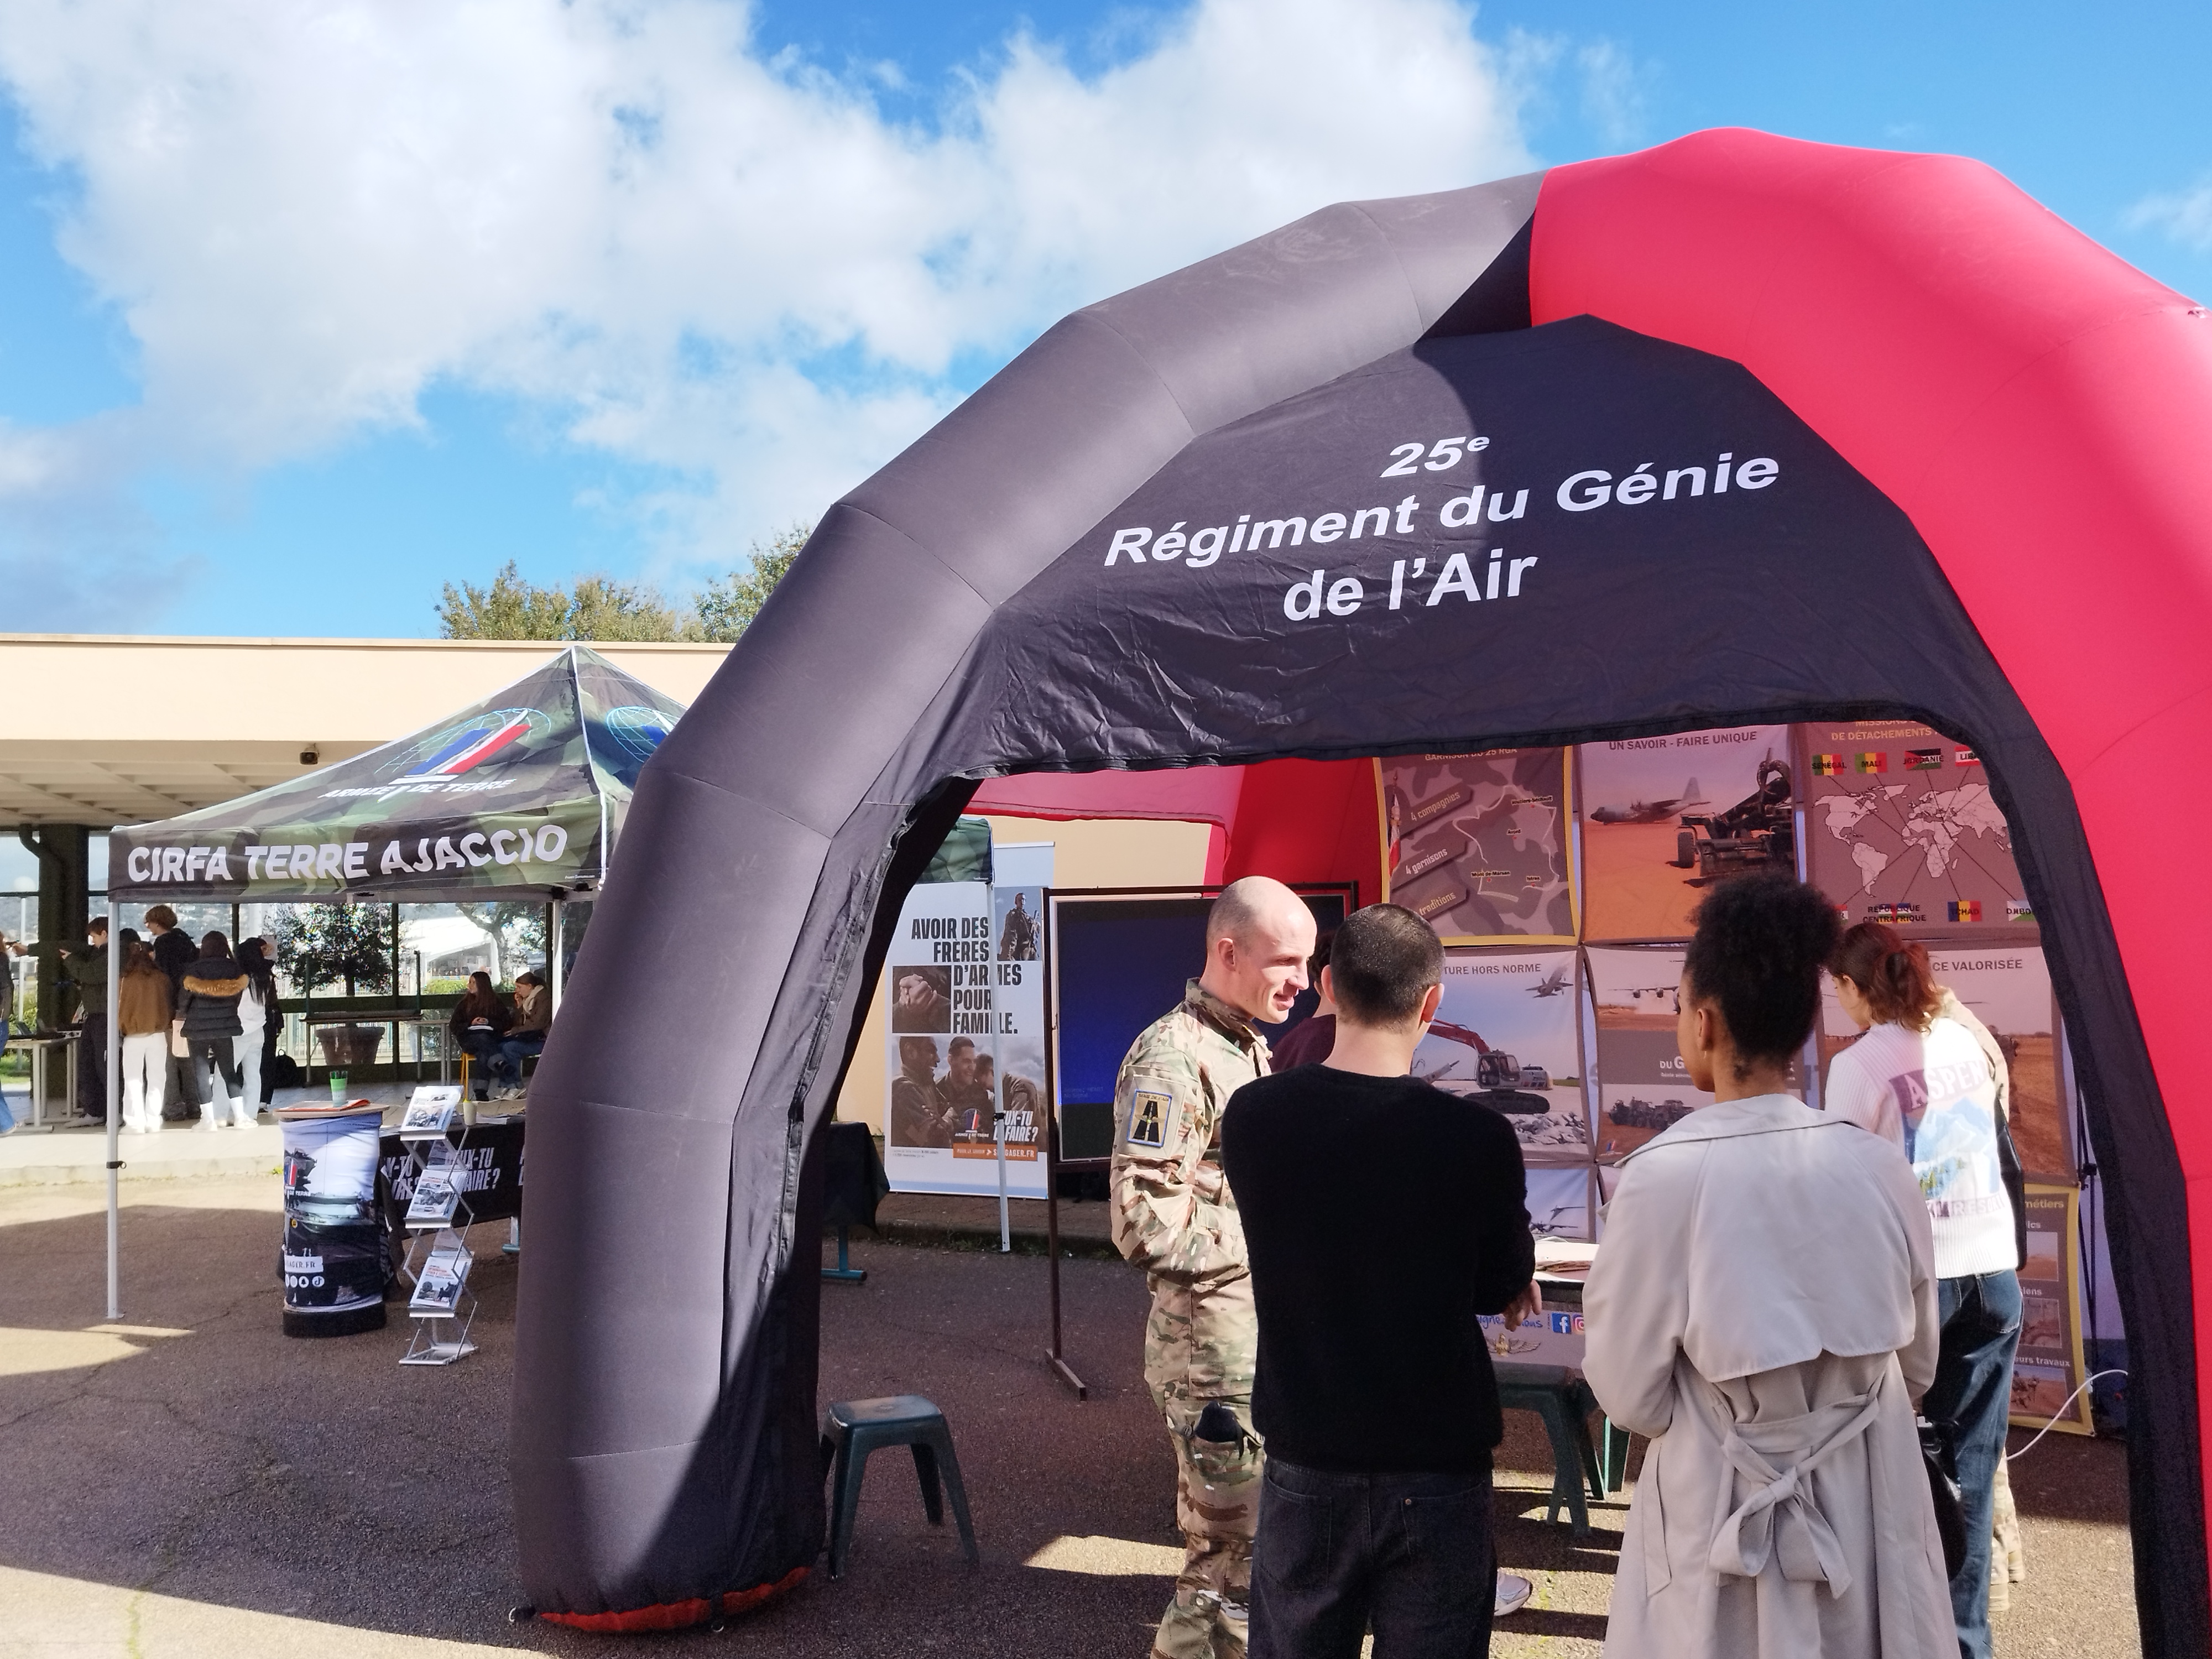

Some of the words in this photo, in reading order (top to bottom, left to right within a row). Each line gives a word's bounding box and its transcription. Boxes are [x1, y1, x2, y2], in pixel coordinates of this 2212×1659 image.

[1380, 435, 1490, 478] 25e
[1104, 493, 1417, 568] Régiment
[1439, 485, 1530, 528] du
[1556, 452, 1780, 513] Génie
[1283, 570, 1364, 622] de
[1389, 549, 1538, 611] l'Air
[1609, 742, 1624, 750] UN
[1627, 739, 1666, 749] SAVOIR
[1677, 736, 1709, 747] FAIRE
[1713, 731, 1757, 744] UNIQUE
[1832, 732, 1844, 740] DE
[1848, 727, 1932, 740] DÉTACHEMENTS
[1861, 760, 1881, 768] MALI
[1903, 754, 1944, 765] JORDANIE
[441, 779, 518, 792] TERRE
[1411, 812, 1417, 821] 4
[1417, 792, 1460, 818] compagnies
[128, 846, 233, 882] CIRFA
[244, 842, 369, 880] TERRE
[380, 825, 568, 875] AJACCIO
[1405, 865, 1411, 874] 4
[1412, 849, 1448, 874] garnisons
[1419, 892, 1456, 916] traditions
[911, 917, 957, 940] AVOIR
[962, 917, 989, 938] DES
[933, 938, 989, 962] FRÈRES
[1472, 966, 1500, 974] HORS
[1503, 963, 1542, 973] NORME
[1952, 957, 2022, 971] VALORISÉE
[953, 989, 992, 1010] POUR
[953, 1012, 1018, 1034] FAMILE.
[1660, 1061, 1672, 1069] DU
[1905, 1060, 1986, 1109] ASPEN
[1005, 1125, 1039, 1142] FAIRE?
[2036, 1357, 2070, 1367] travaux
